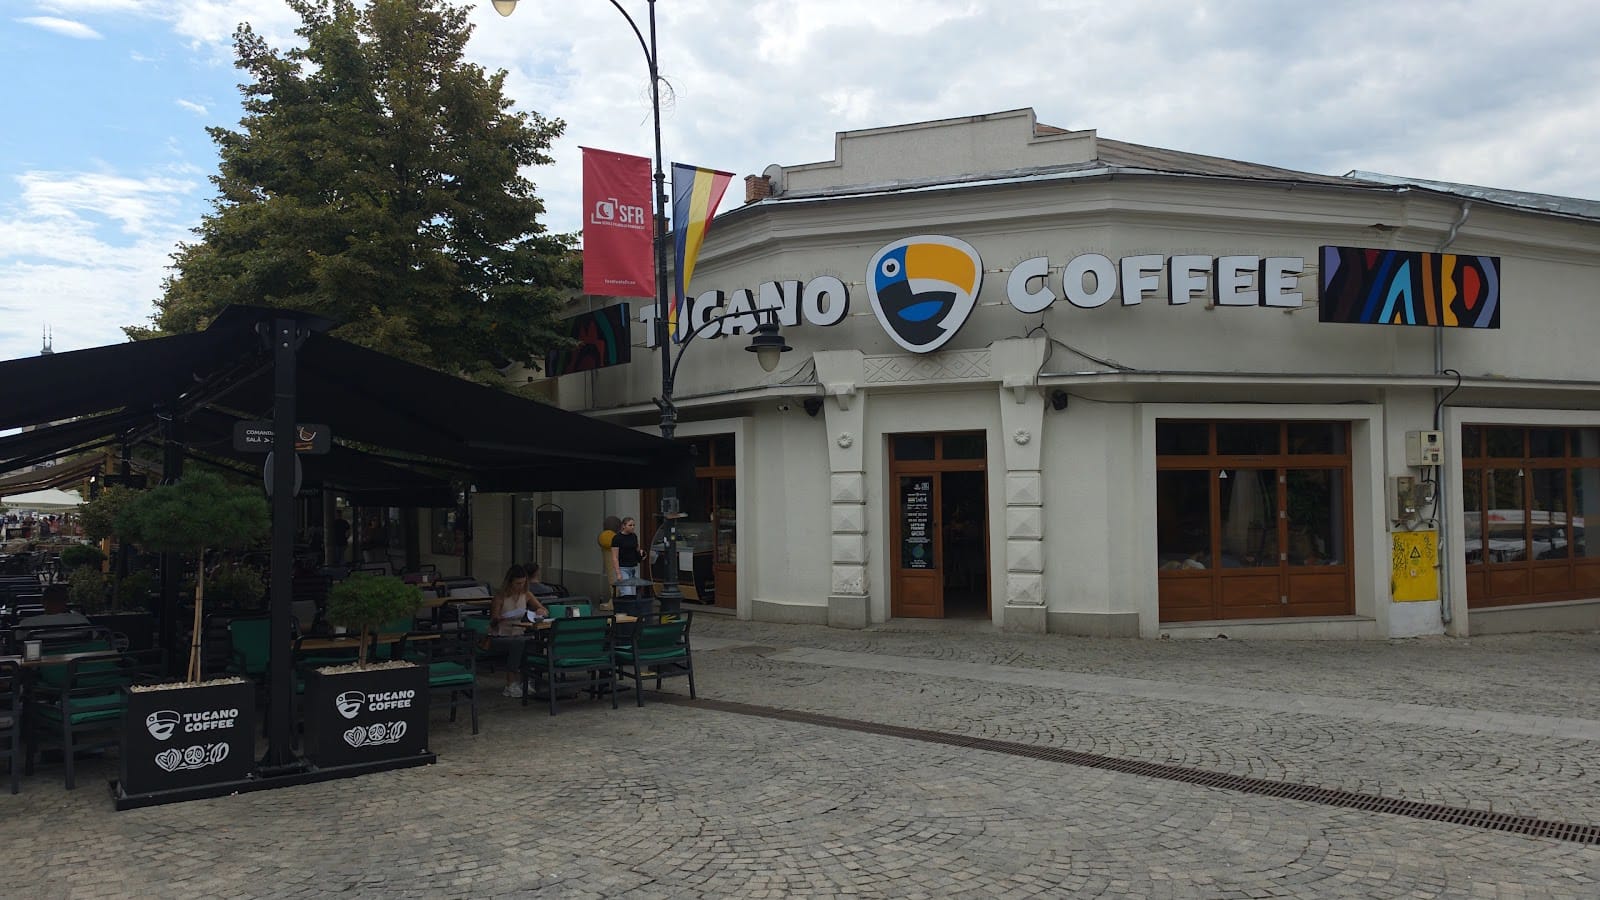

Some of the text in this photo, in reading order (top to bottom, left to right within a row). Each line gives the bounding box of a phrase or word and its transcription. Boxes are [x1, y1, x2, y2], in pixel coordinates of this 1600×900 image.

[619, 205, 644, 224] SFR
[1006, 253, 1304, 313] COFFEE
[368, 690, 415, 702] TUCANO
[369, 699, 411, 711] COFFEE
[183, 708, 239, 723] TUCANO
[184, 719, 234, 732] COFFEE
